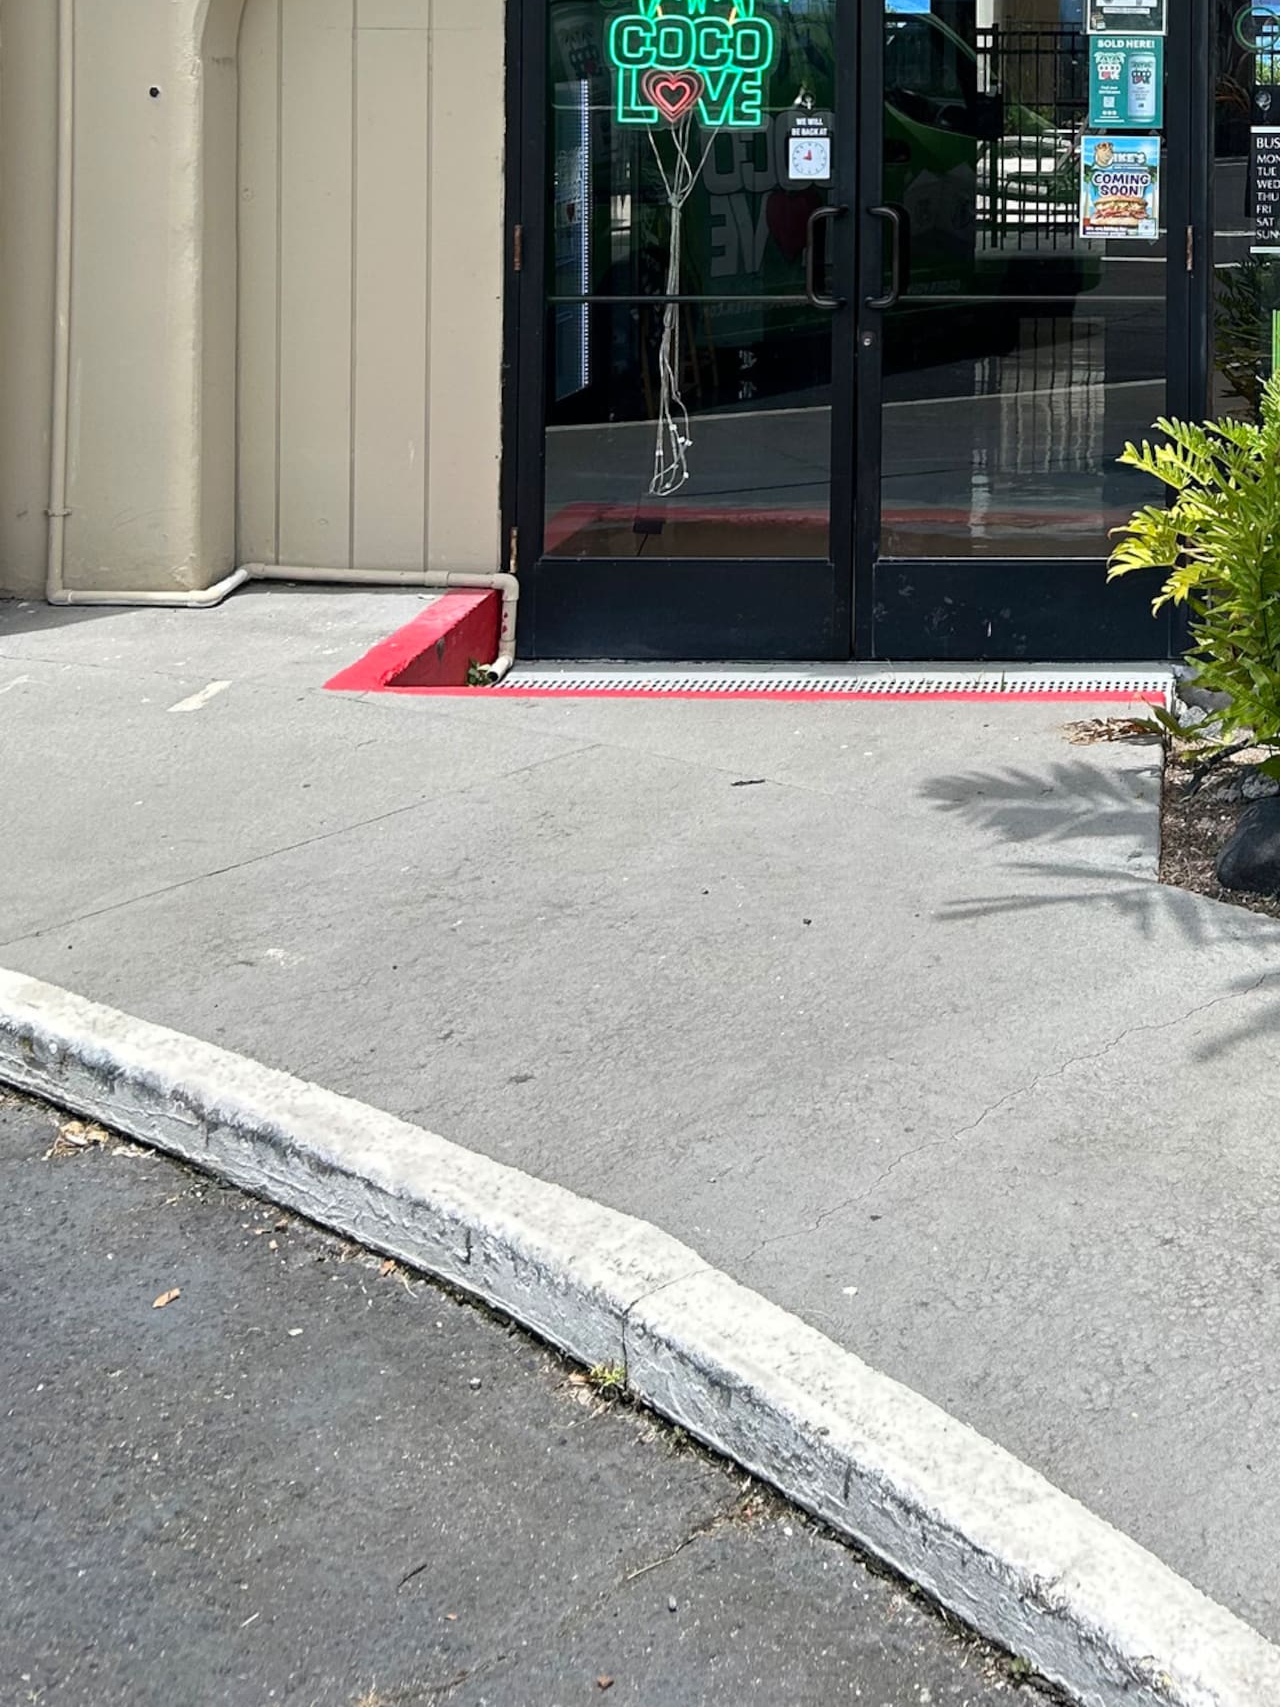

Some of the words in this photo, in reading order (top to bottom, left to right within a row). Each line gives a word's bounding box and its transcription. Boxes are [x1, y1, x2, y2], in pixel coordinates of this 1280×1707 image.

[609, 14, 774, 72] COCO
[1097, 39, 1124, 48] SOLD
[1126, 39, 1155, 49] HERE!
[795, 117, 806, 125] WE
[808, 117, 823, 125] WILL
[791, 127, 800, 136] BE
[801, 127, 818, 136] BACK
[1256, 167, 1277, 176] TUE
[1093, 174, 1149, 185] COMING
[1256, 193, 1279, 201] THU
[1256, 205, 1272, 214] FRI
[1256, 217, 1275, 226] SAT
[1256, 230, 1279, 239] SUN
